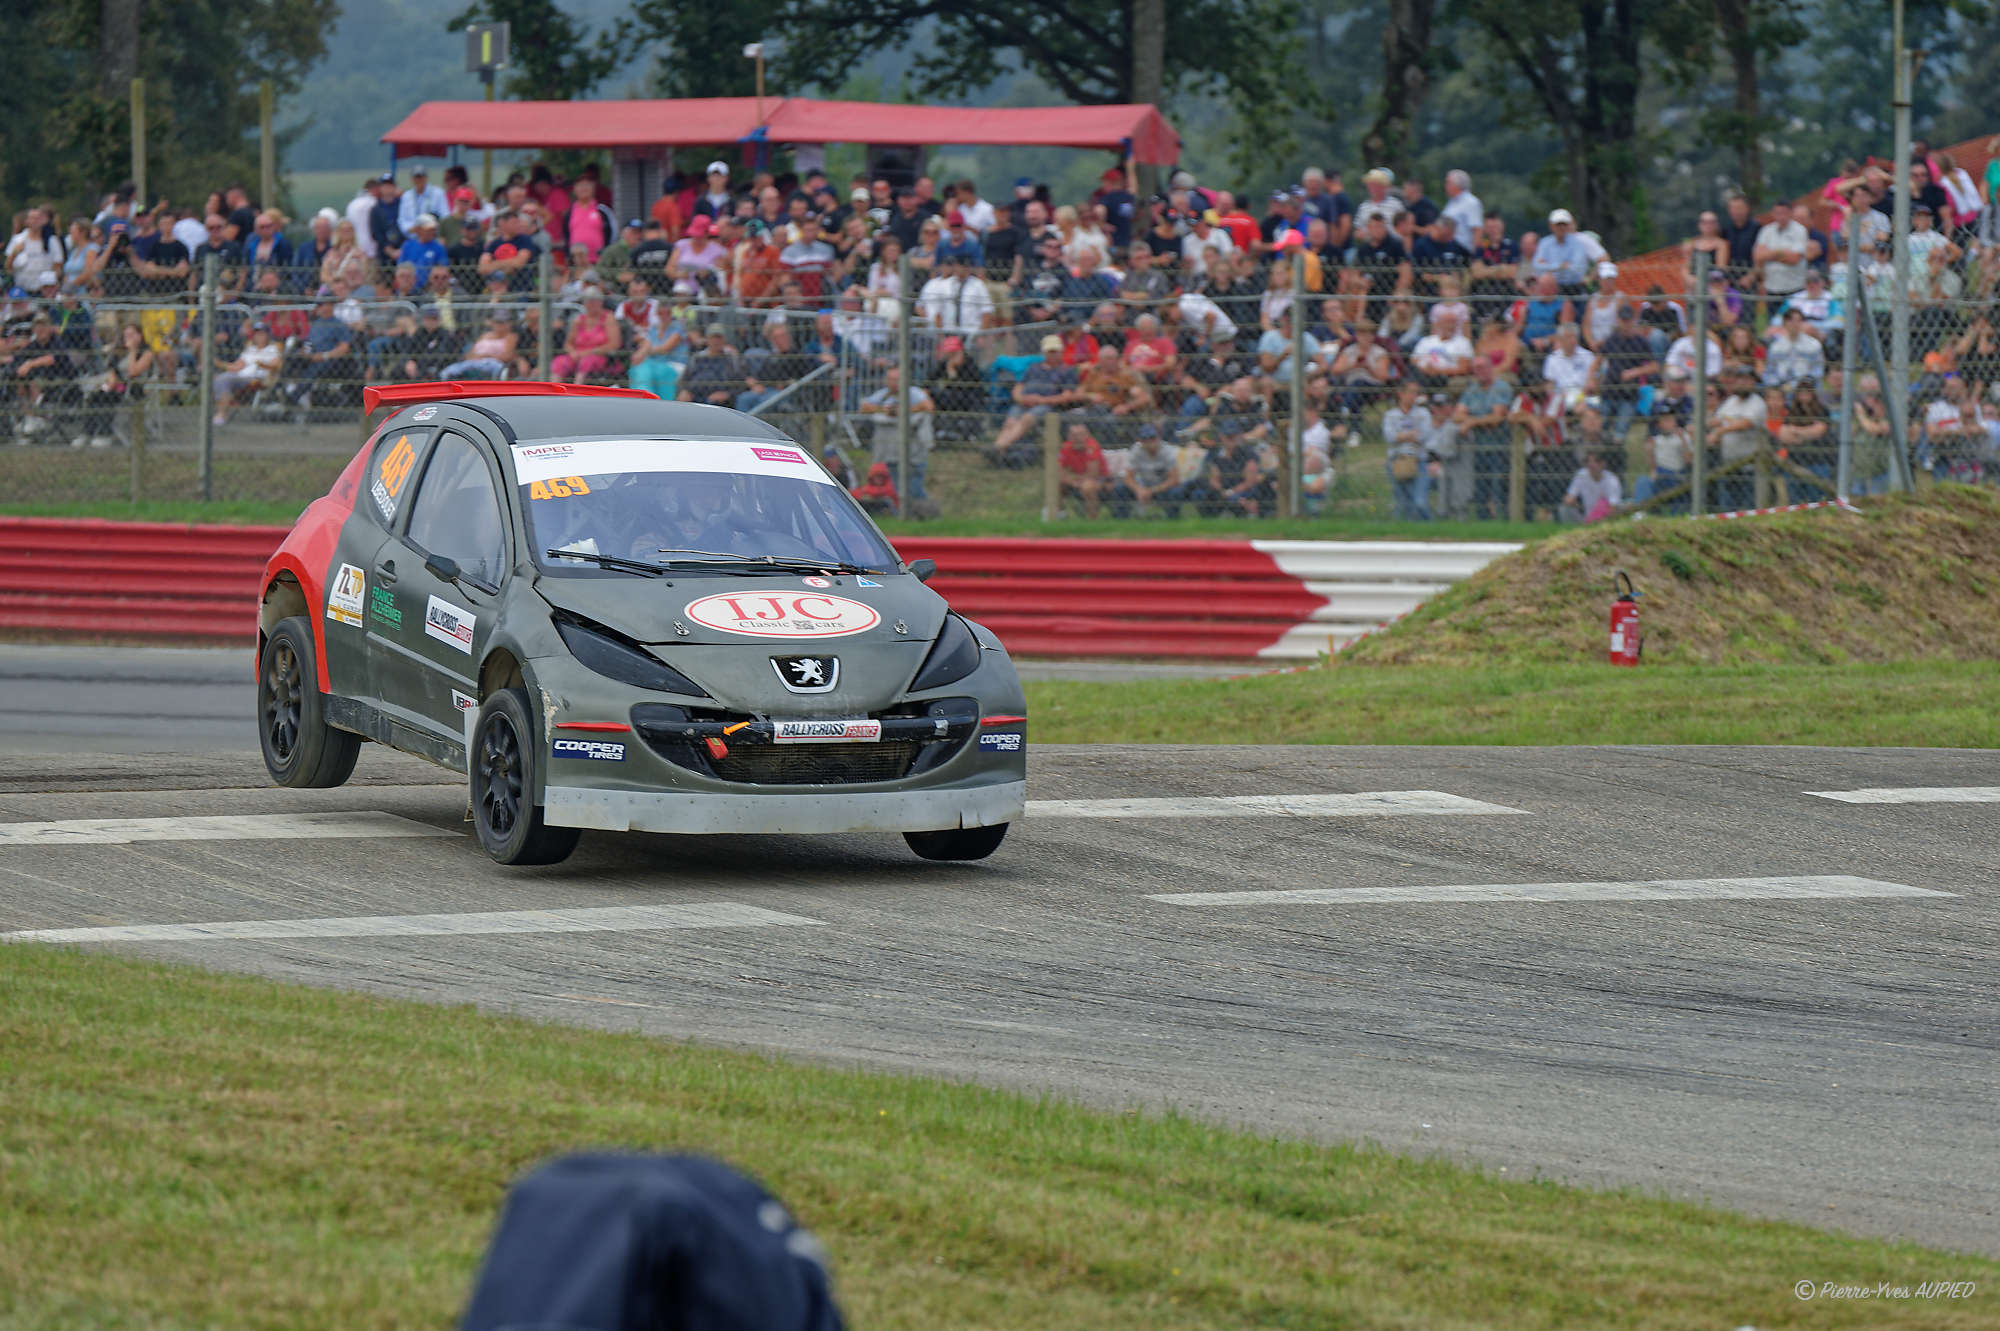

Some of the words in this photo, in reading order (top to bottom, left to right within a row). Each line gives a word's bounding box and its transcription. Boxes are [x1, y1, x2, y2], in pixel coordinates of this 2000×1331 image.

[522, 445, 574, 456] IMPEC
[381, 435, 415, 497] 469
[530, 476, 590, 500] 469
[718, 597, 842, 621] IJC
[430, 606, 458, 633] RALLYCROSS
[739, 620, 790, 628] Classic
[781, 723, 845, 736] RALLYCROSS
[980, 734, 1021, 744] COOPER
[553, 740, 625, 753] COOPER
[588, 751, 623, 760] TIRES
